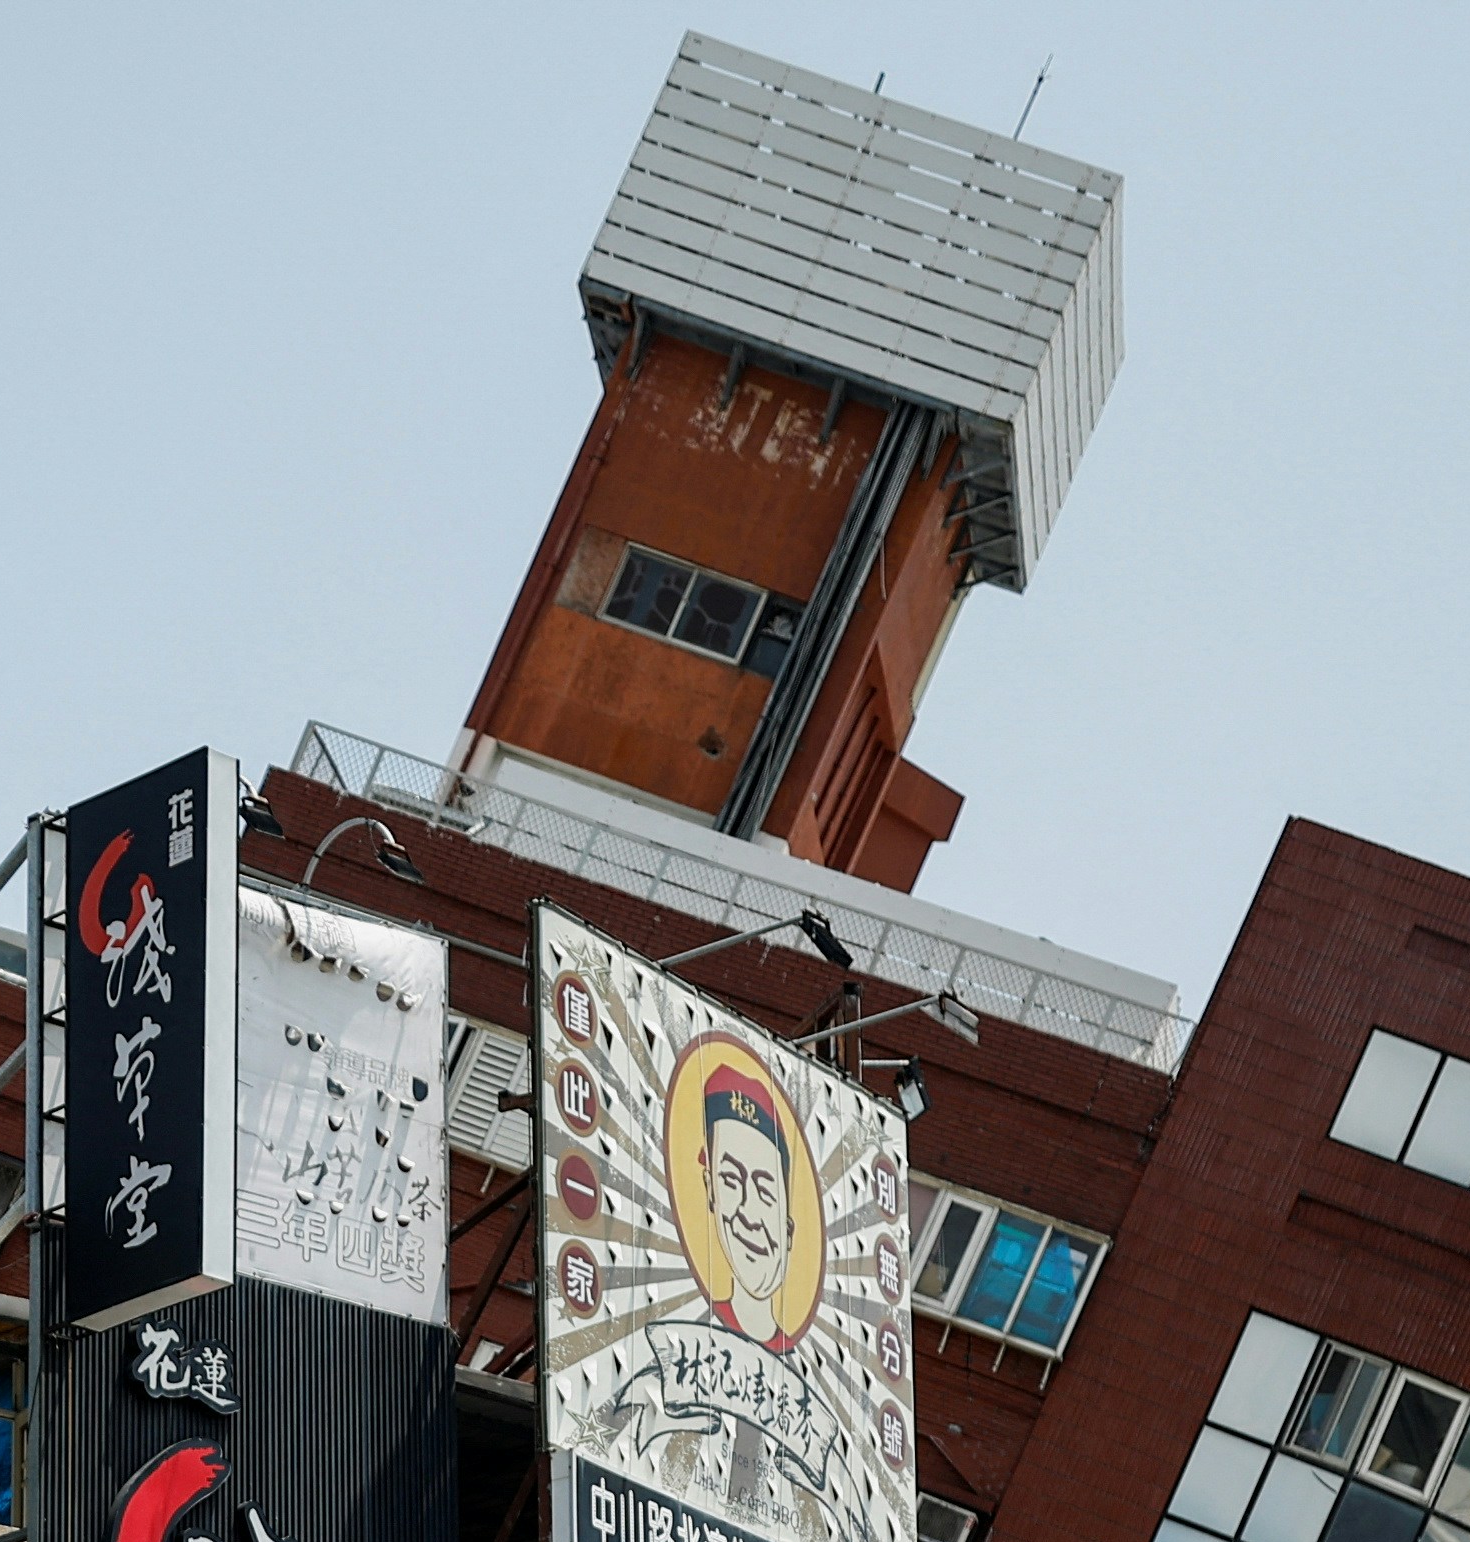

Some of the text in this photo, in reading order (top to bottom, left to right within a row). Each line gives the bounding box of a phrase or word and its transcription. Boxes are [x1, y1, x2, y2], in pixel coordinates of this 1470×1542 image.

[168, 788, 194, 868] 花蓮
[560, 982, 597, 1306] 僅此一家
[138, 1322, 237, 1409] 花蓮
[875, 1167, 904, 1455] 別無分號
